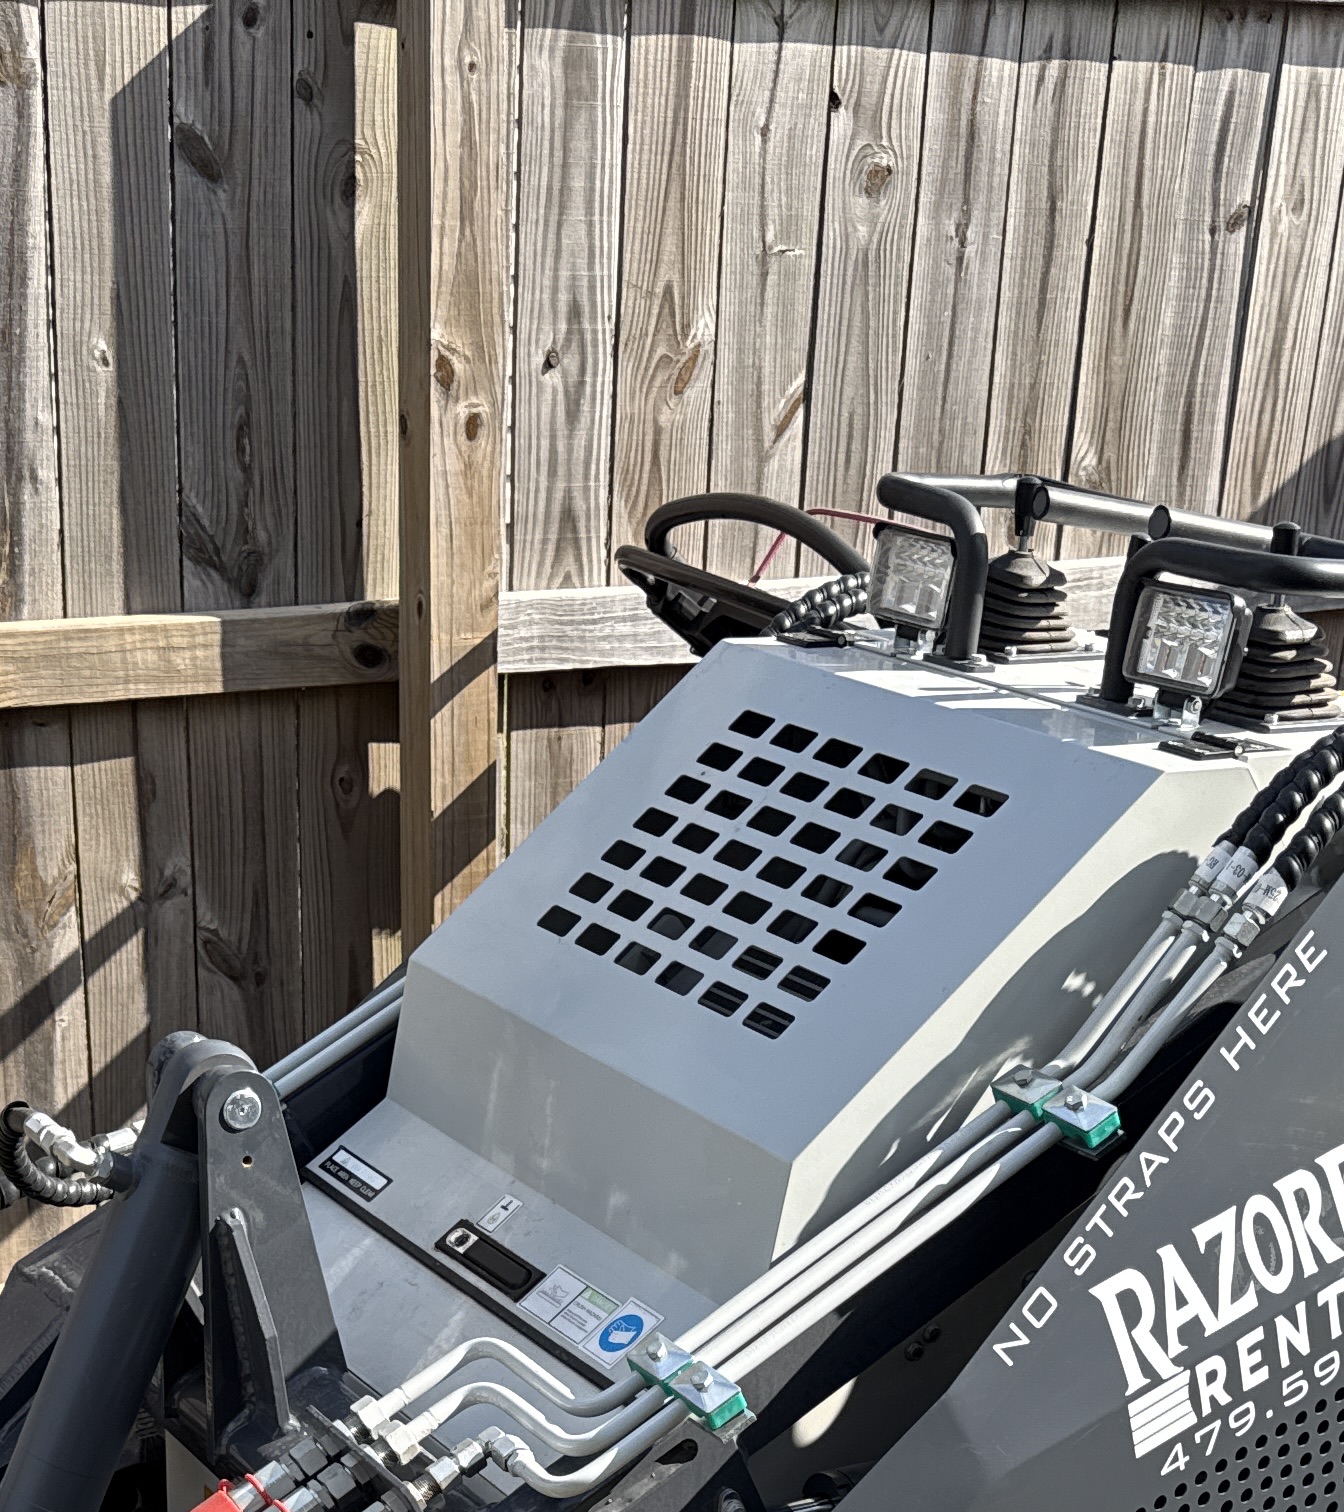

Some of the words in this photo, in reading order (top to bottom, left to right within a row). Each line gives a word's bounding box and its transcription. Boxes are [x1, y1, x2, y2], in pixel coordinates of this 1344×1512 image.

[993, 1286, 1058, 1368] NO
[1064, 1080, 1216, 1276] STRAPS
[1219, 930, 1328, 1071] HERE
